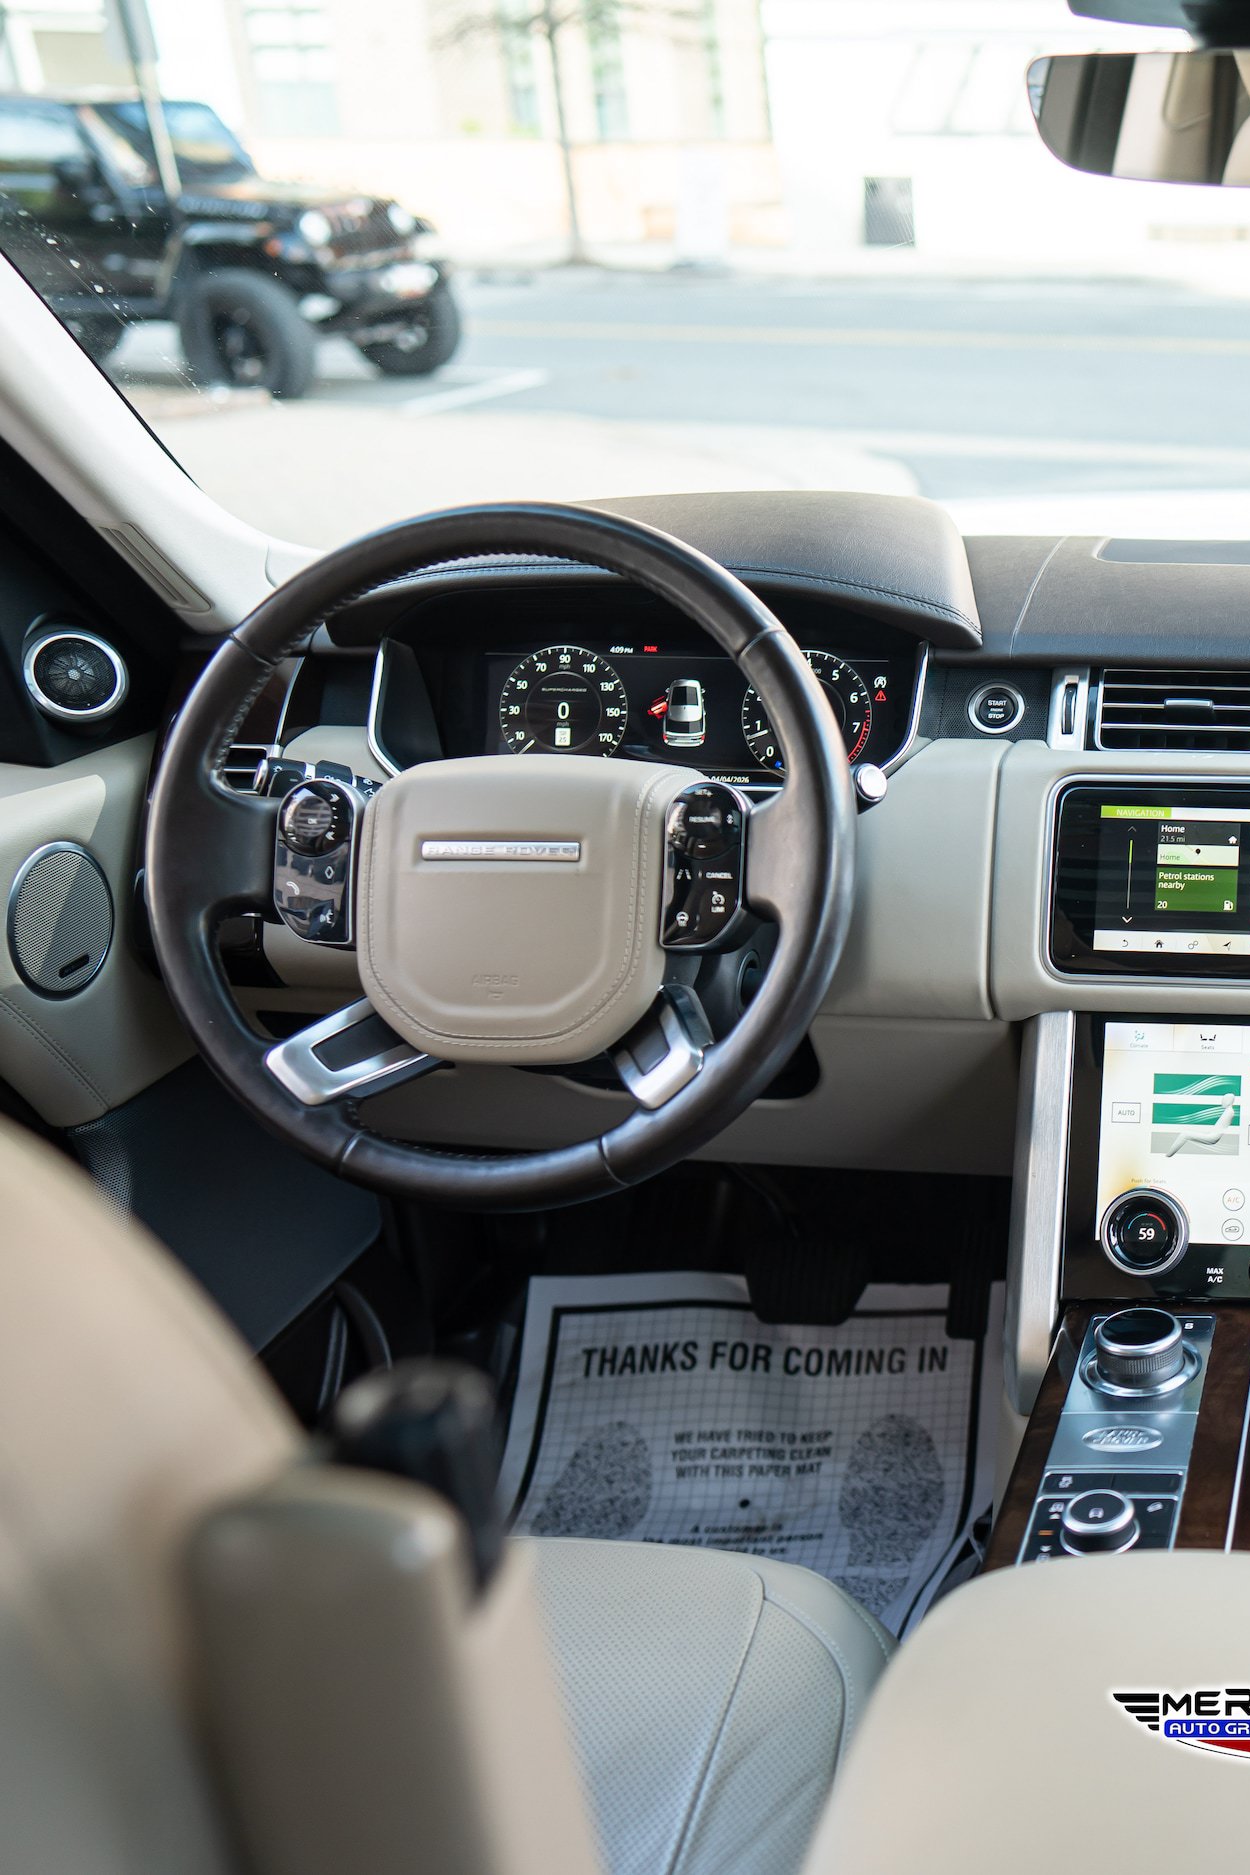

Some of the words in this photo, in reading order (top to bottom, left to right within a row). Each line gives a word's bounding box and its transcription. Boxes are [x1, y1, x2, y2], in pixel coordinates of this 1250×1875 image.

[559, 654, 571, 664] 90
[536, 663, 547, 672] 70
[583, 664, 595, 673] 110
[831, 670, 840, 680] 5
[516, 680, 528, 690] 50
[600, 682, 614, 691] 130
[850, 693, 858, 703] 6
[509, 705, 520, 715] 30
[558, 702, 569, 719] 0
[606, 708, 620, 717] 150
[756, 720, 760, 730] 1
[852, 722, 861, 733] 7
[515, 732, 525, 740] 10
[599, 732, 613, 742] 170
[766, 746, 774, 757] 0
[428, 846, 494, 856] RANGE
[1184, 873, 1214, 881] stations
[1158, 881, 1185, 890] nearby
[472, 975, 520, 987] AIRBAG
[1138, 1228, 1155, 1240] 59
[582, 1341, 698, 1378] THANKS
[710, 1341, 773, 1374] FOR
[782, 1348, 907, 1378] COMING
[917, 1346, 949, 1373] IN
[674, 1432, 692, 1444] WE
[698, 1431, 730, 1443] HAVE
[737, 1430, 775, 1442] TRIED
[781, 1432, 796, 1444] TO
[800, 1431, 832, 1443] KEEP
[671, 1448, 706, 1460] YOUR
[710, 1447, 785, 1460] CARPETING
[790, 1446, 831, 1460] CLEAN
[676, 1464, 710, 1478] WITH
[715, 1465, 743, 1478] THIS
[748, 1464, 790, 1477] PAPER
[796, 1462, 822, 1474] MAT
